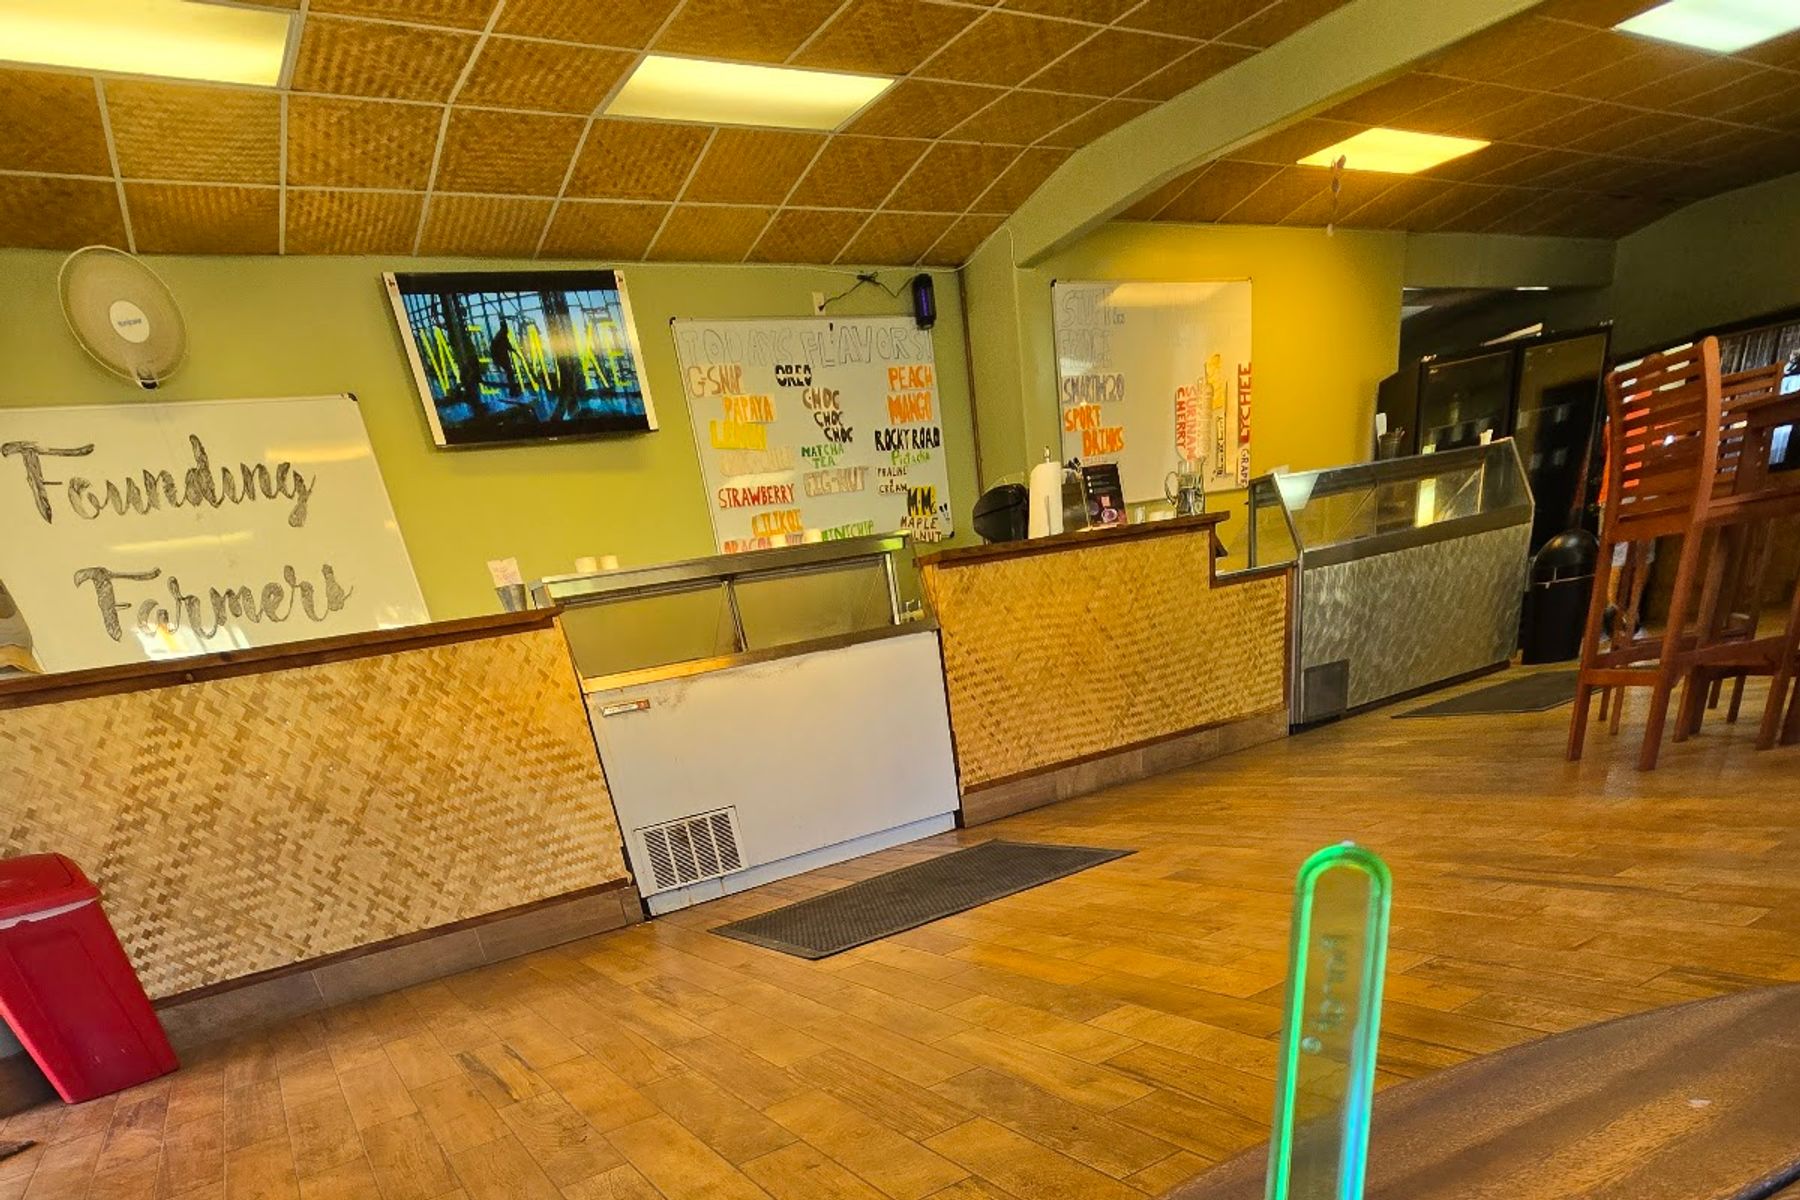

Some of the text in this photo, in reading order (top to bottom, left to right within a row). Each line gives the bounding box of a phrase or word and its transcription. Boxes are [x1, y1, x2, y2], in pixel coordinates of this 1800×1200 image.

[506, 318, 634, 394] MKE
[888, 366, 933, 390] PEACH
[723, 395, 774, 423] PAPAYA
[803, 388, 840, 410] CHOC
[887, 391, 933, 425] MANGO
[814, 411, 844, 427] CHOC
[1064, 405, 1101, 432] SPORT
[1175, 386, 1187, 449] CHERRY
[825, 427, 853, 443] CHOC
[874, 427, 940, 451] ROCKY ROAD
[1082, 426, 1124, 457] DRINKS
[801, 443, 845, 457] MATCHA
[812, 456, 837, 469] TEA
[1, 434, 317, 528] Founding
[717, 484, 795, 509] STRAWBERRY
[900, 516, 939, 530] MAPLE
[73, 563, 354, 643] Farmers
